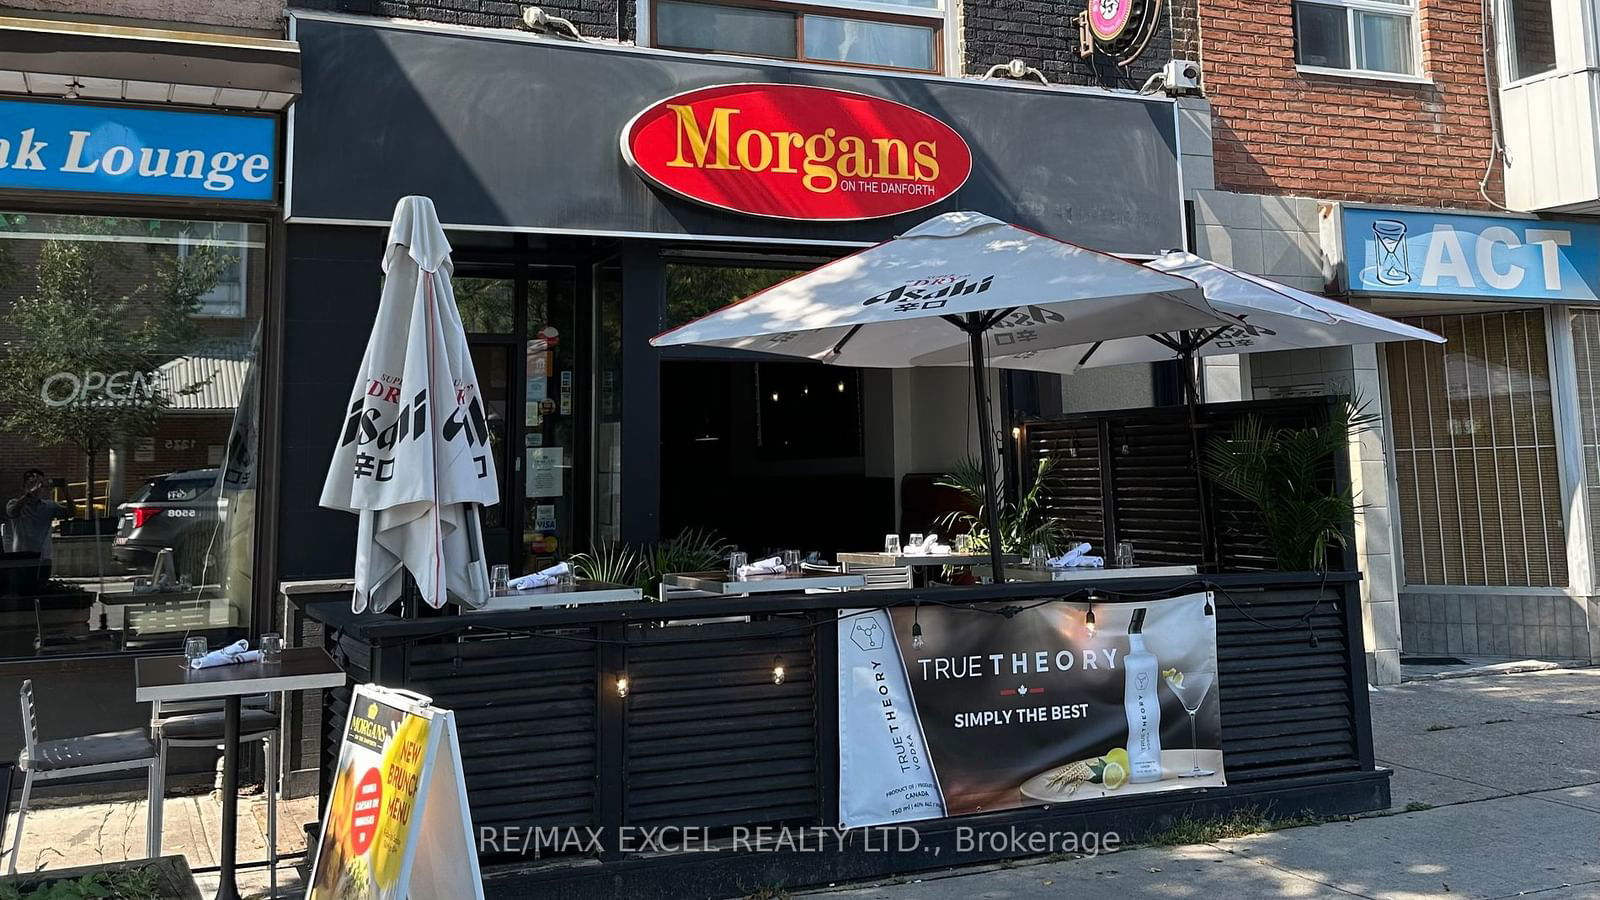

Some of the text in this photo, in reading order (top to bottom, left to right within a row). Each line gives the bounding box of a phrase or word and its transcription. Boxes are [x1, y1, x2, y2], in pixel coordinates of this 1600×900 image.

[60, 131, 269, 191] Lounge
[666, 104, 940, 193] Morgans
[840, 180, 935, 196] ON THE DANFORTH
[1420, 223, 1572, 291] ACT
[863, 274, 995, 306] Asahi
[41, 371, 157, 407] OPEN
[368, 380, 400, 404] DR
[537, 521, 556, 529] VISA
[918, 648, 1117, 681] TRUE THEORY
[350, 715, 388, 743] MORGANS
[871, 661, 911, 773] TRUE THEORY
[954, 704, 1089, 728] SIMPLY THE BEST
[400, 739, 422, 766] NEW
[906, 734, 921, 771] VODKA
[886, 785, 908, 798] PRODUCT
[905, 790, 930, 800] CANADA
[386, 797, 410, 827] MENU
[891, 807, 902, 816] 750
